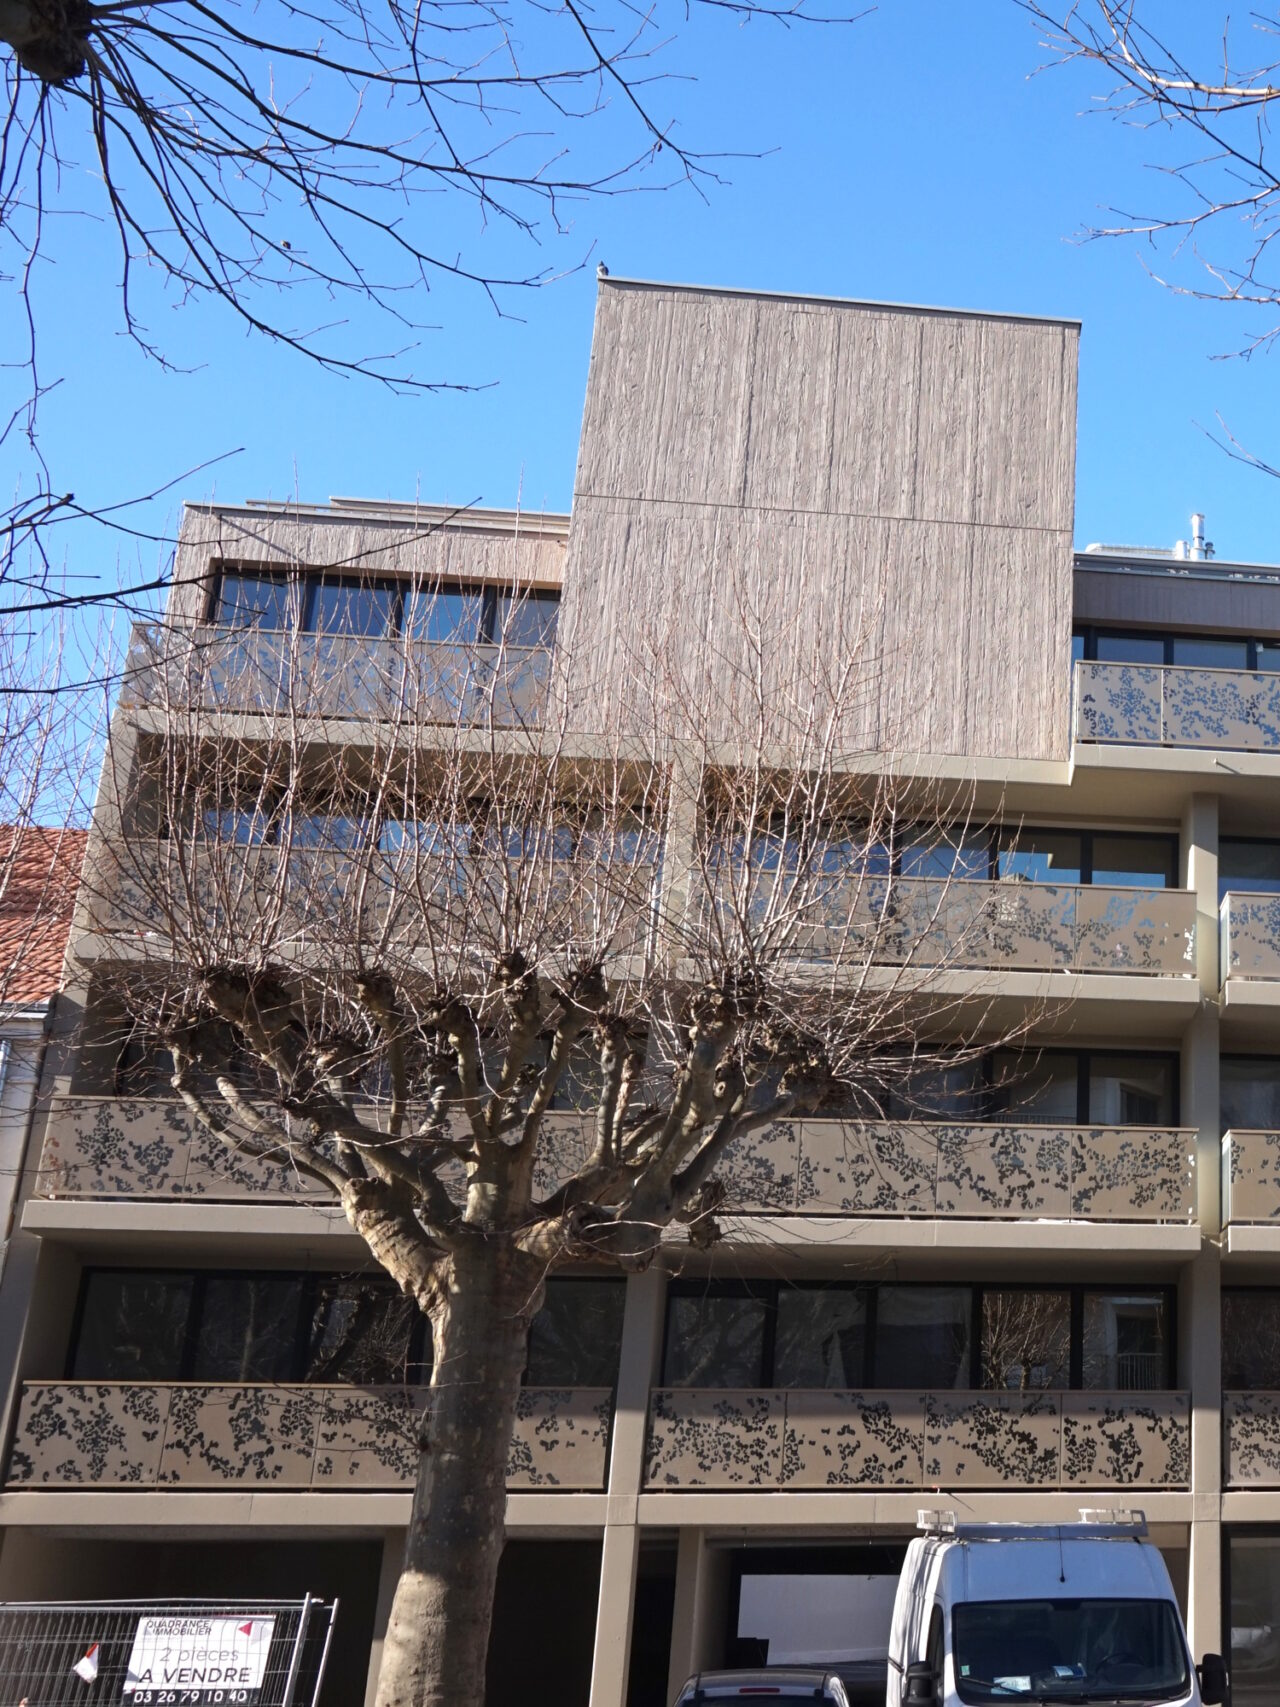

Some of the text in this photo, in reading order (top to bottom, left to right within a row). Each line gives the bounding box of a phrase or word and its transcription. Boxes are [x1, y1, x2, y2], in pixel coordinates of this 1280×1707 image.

[160, 1647, 239, 1663] 2 pièces
[139, 1667, 251, 1683] A VENDRE
[134, 1690, 247, 1703] 03 26 79 10 40
